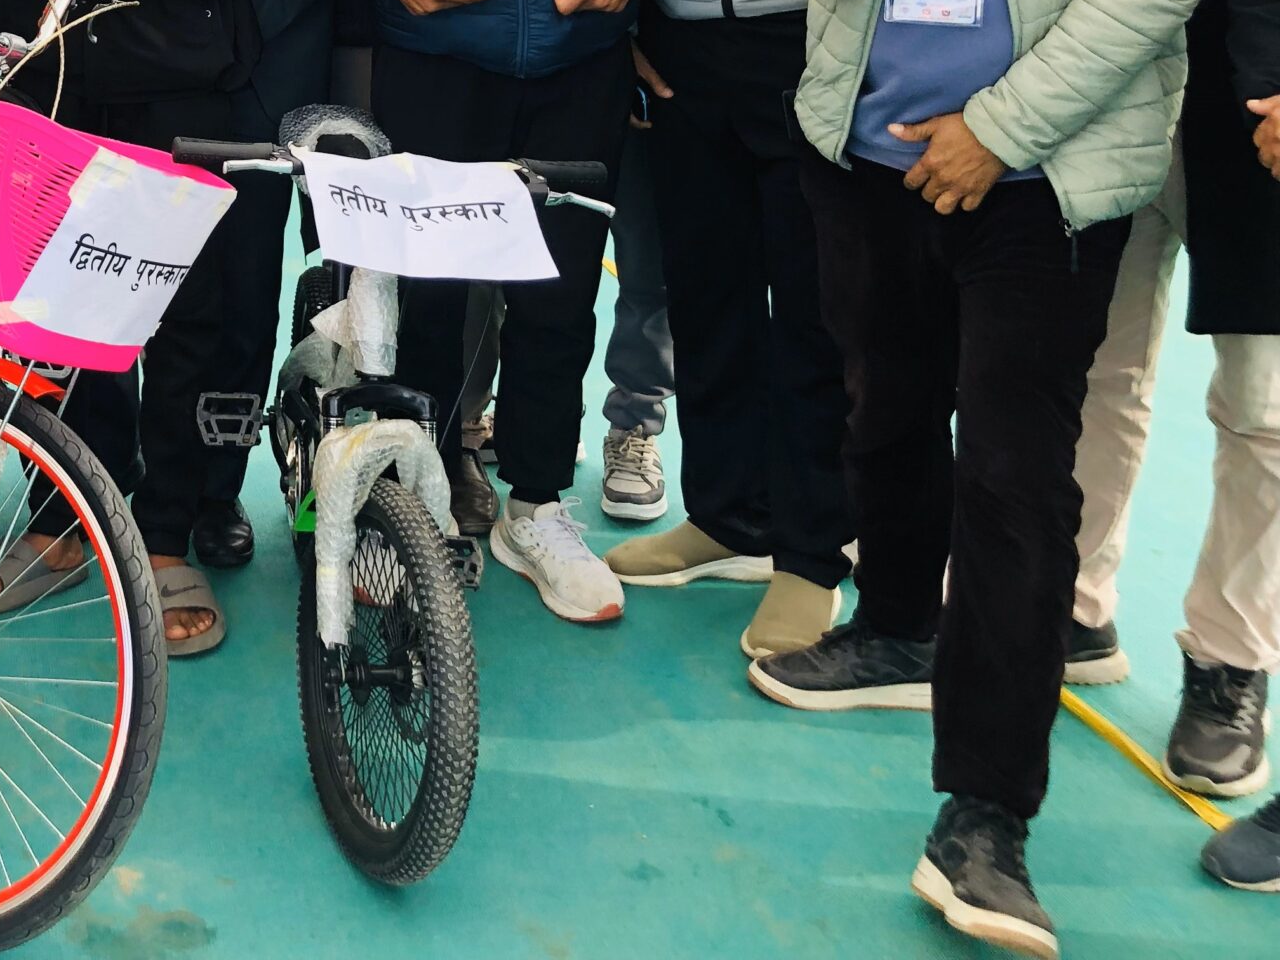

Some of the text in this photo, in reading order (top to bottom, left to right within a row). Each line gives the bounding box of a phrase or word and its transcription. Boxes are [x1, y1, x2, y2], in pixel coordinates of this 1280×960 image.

[328, 183, 508, 231] तृतीय पुरस्कार
[70, 233, 131, 277] द्वितीय
